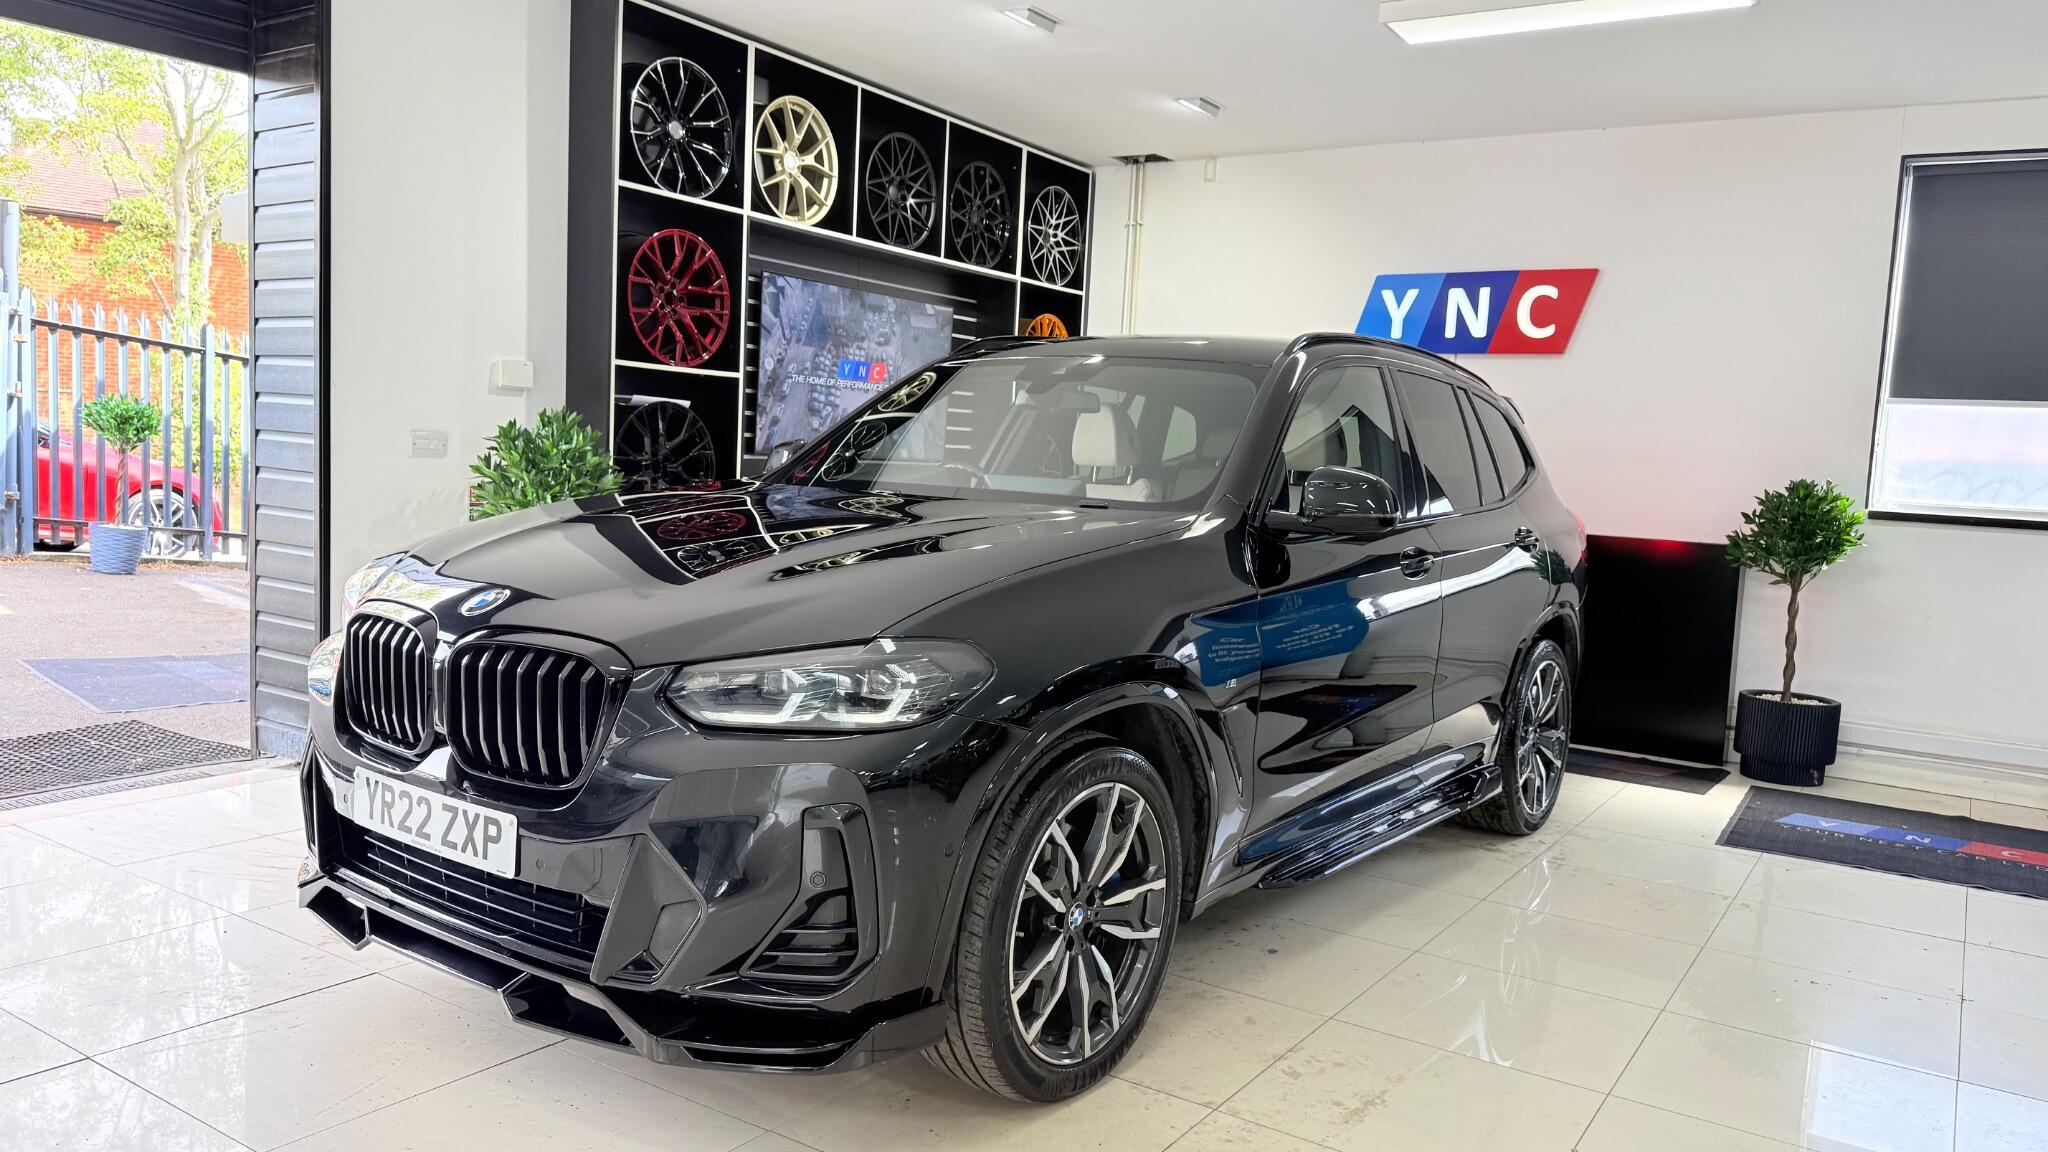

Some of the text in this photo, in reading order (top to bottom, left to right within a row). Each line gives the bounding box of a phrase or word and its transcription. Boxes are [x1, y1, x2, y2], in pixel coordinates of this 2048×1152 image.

[1381, 285, 1559, 339] YNC
[792, 374, 805, 382] THE
[806, 376, 826, 386] HOME
[827, 379, 836, 387] OF
[837, 380, 883, 391] PERFORMANCE
[844, 364, 880, 379] YNC
[366, 777, 502, 861] YR22 ZXP
[1780, 823, 1845, 837] YOUR
[1859, 836, 1923, 850] NEXT
[1938, 849, 1987, 862] CAR
